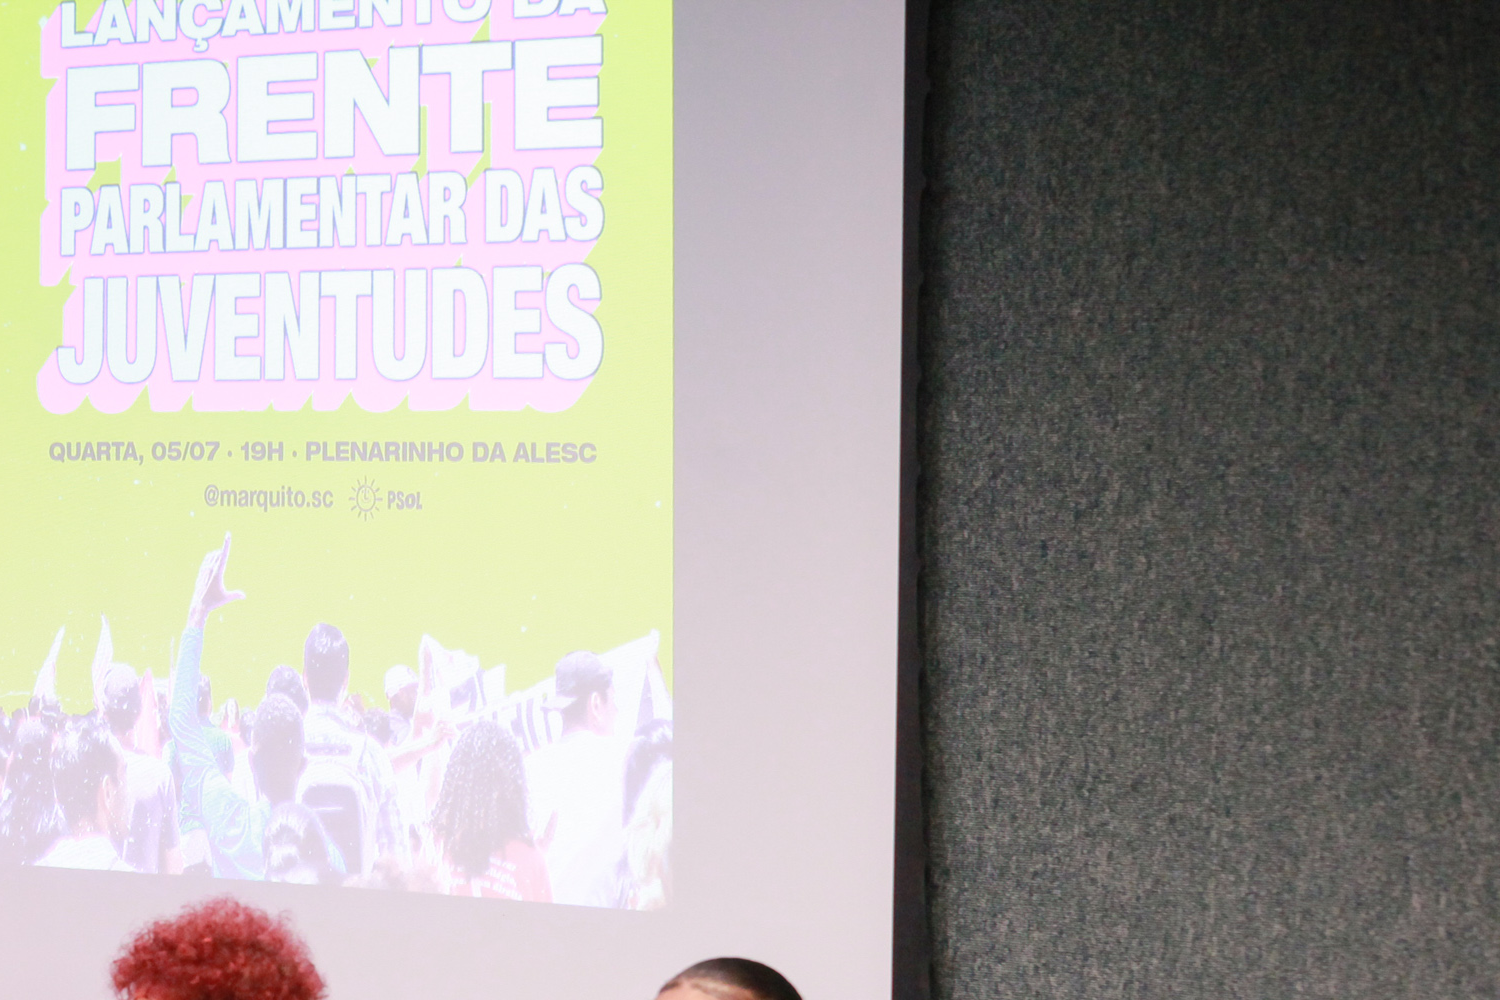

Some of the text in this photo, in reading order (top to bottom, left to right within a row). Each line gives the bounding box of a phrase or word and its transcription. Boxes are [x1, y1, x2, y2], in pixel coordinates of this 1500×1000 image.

[65, 34, 604, 171] FRENTE
[60, 164, 605, 256] PARLAMENTAR DAS
[56, 262, 605, 385] JUVENTUDES
[48, 440, 598, 466] QUARTA, 05/07 19H PLENARINHO DA ALESC
[203, 484, 335, 513] @marquito.sc
